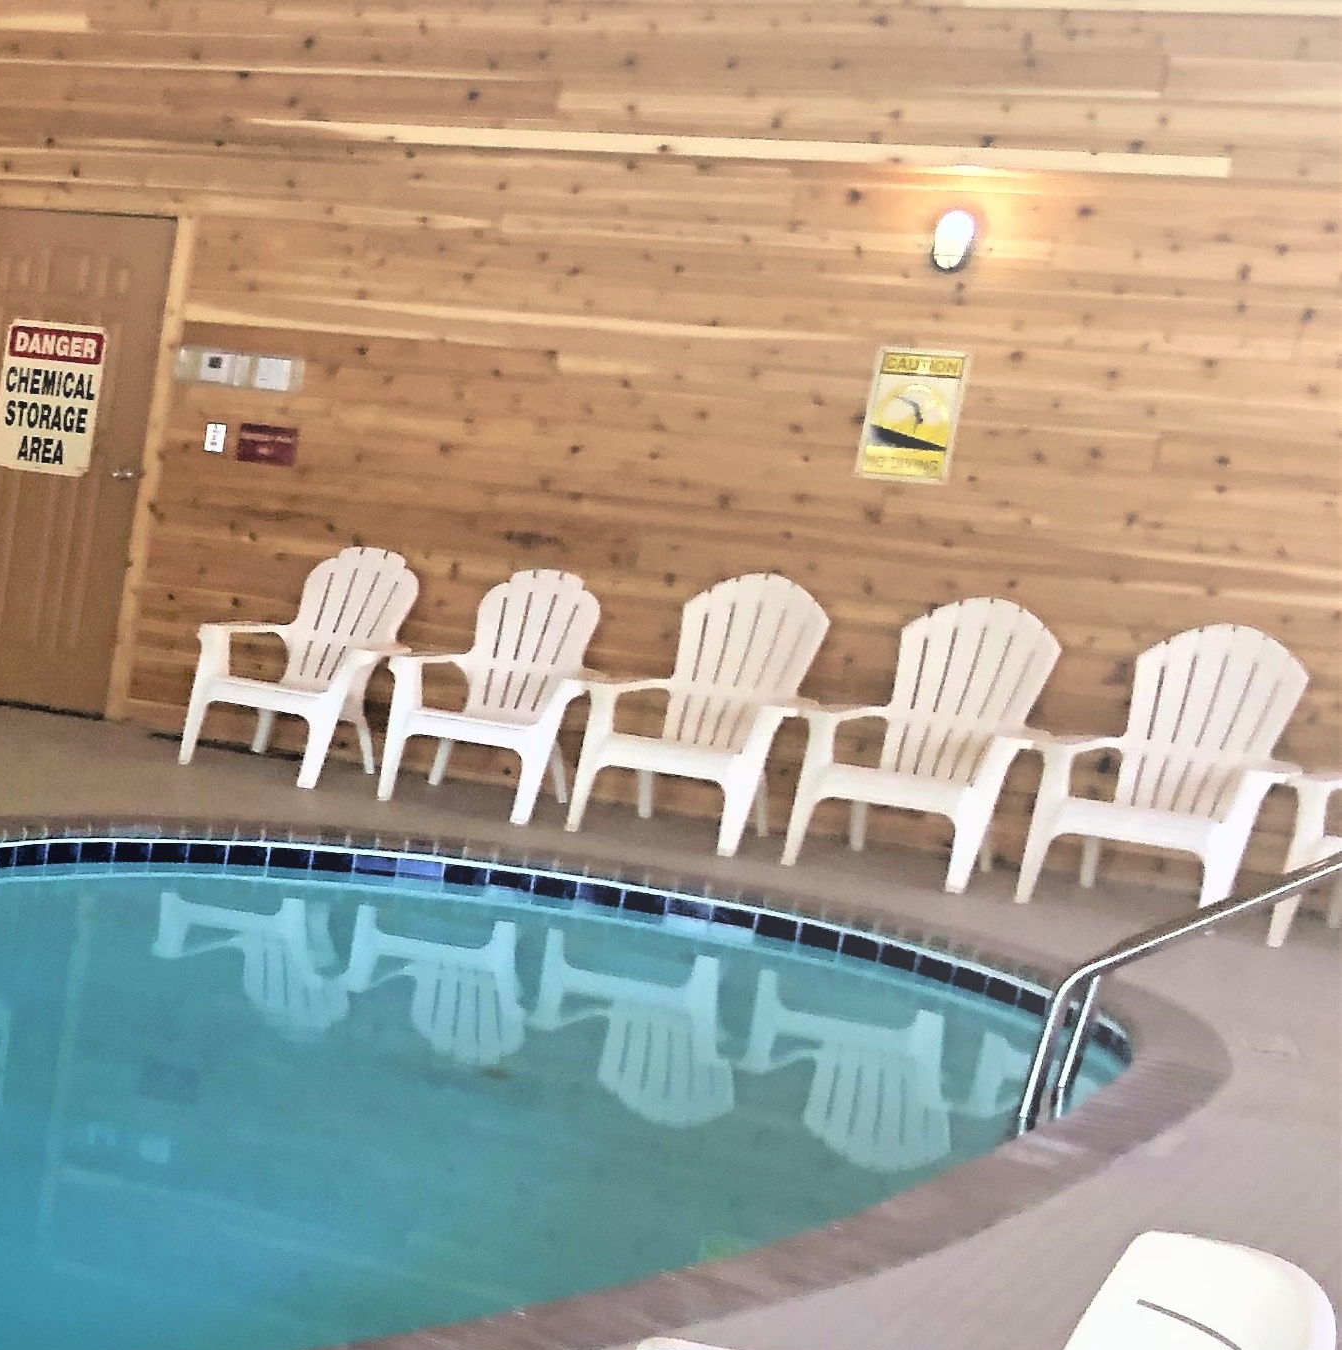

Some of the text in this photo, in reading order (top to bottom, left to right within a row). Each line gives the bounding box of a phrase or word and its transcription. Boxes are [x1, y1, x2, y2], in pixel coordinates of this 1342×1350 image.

[15, 331, 97, 359] DANGER
[888, 357, 959, 374] CAUTION
[5, 366, 96, 401] CHEMICAL
[5, 400, 89, 433] STORAGE
[17, 435, 64, 465] AREA
